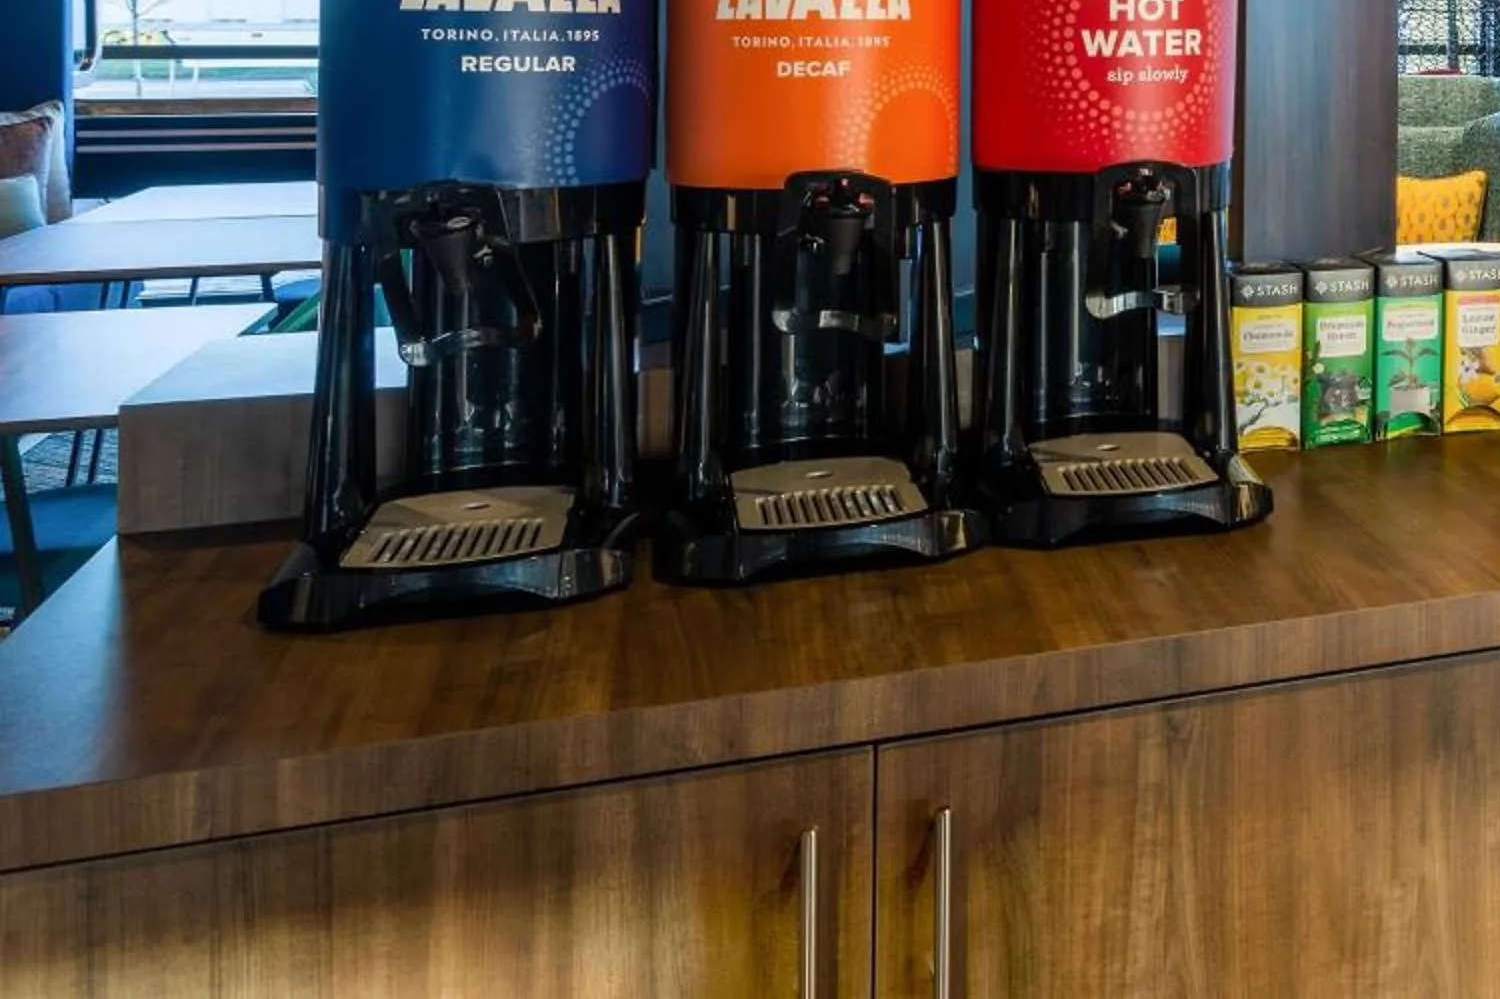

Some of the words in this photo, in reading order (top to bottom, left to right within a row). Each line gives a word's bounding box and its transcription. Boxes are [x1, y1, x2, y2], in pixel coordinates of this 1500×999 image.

[567, 30, 600, 42] 1895
[1081, 29, 1202, 57] WATER
[461, 55, 576, 72] REGULAR
[777, 61, 851, 77] DECAF
[1107, 68, 1135, 86] sip
[1138, 64, 1189, 83] slowly
[1329, 280, 1369, 293] STASH
[1402, 275, 1437, 287] STASH
[1256, 282, 1297, 297] STASH
